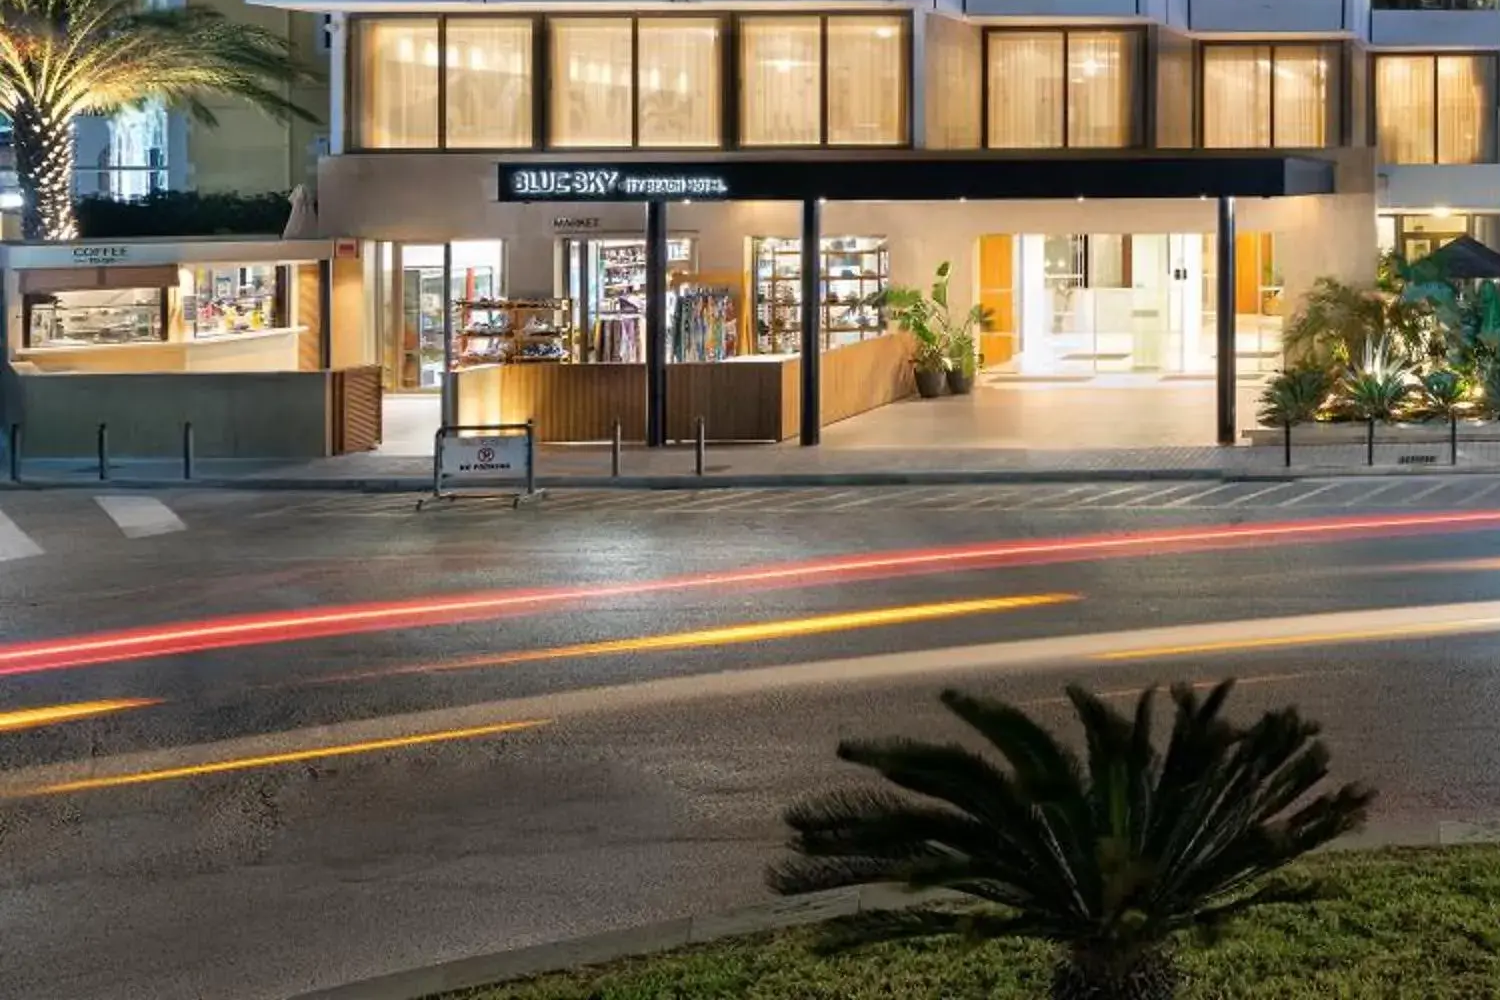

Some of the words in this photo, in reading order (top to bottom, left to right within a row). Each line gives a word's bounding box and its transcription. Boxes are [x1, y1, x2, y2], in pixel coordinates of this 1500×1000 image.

[515, 171, 571, 193] BLUE
[573, 171, 618, 194] SKY
[73, 247, 128, 257] COFFEE
